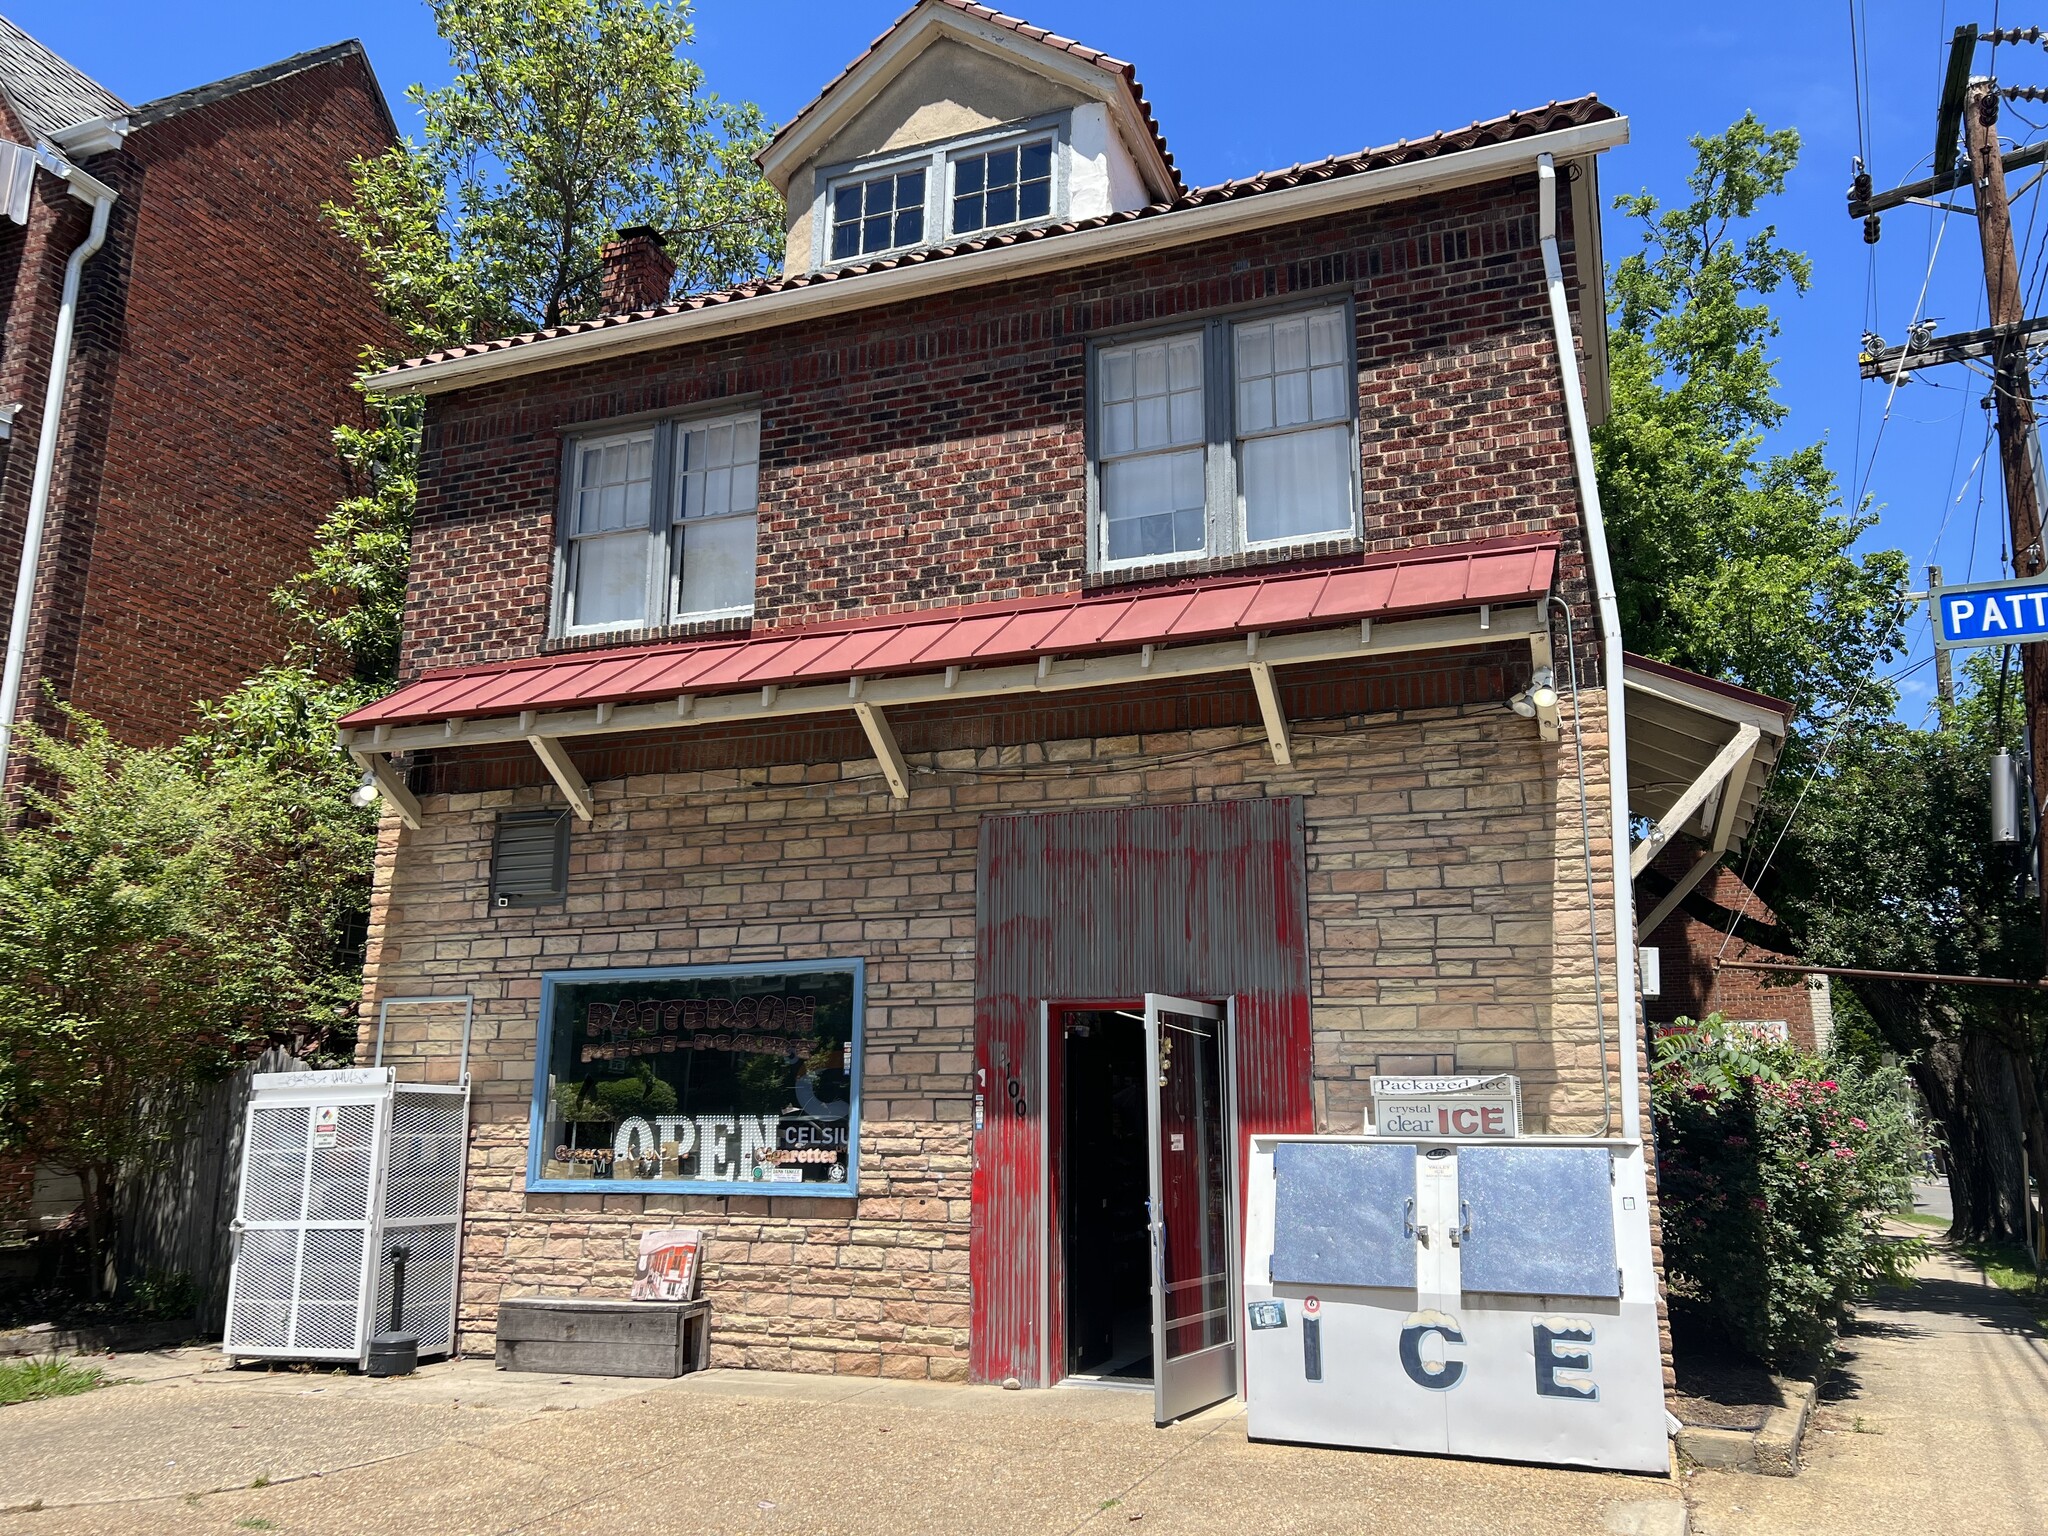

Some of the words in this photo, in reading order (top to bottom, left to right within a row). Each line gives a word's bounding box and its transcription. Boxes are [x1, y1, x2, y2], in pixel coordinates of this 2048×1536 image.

[1950, 592, 2048, 634] PATT
[587, 995, 816, 1037] PATTERSON
[1379, 1079, 1469, 1092] Packaged
[1387, 1115, 1434, 1132] clear
[1388, 1104, 1431, 1115] crystal
[1437, 1104, 1506, 1135] ICE
[614, 1115, 780, 1182] OPEN
[754, 1146, 838, 1166] Cigarettes
[1302, 1309, 1600, 1402] ICE
